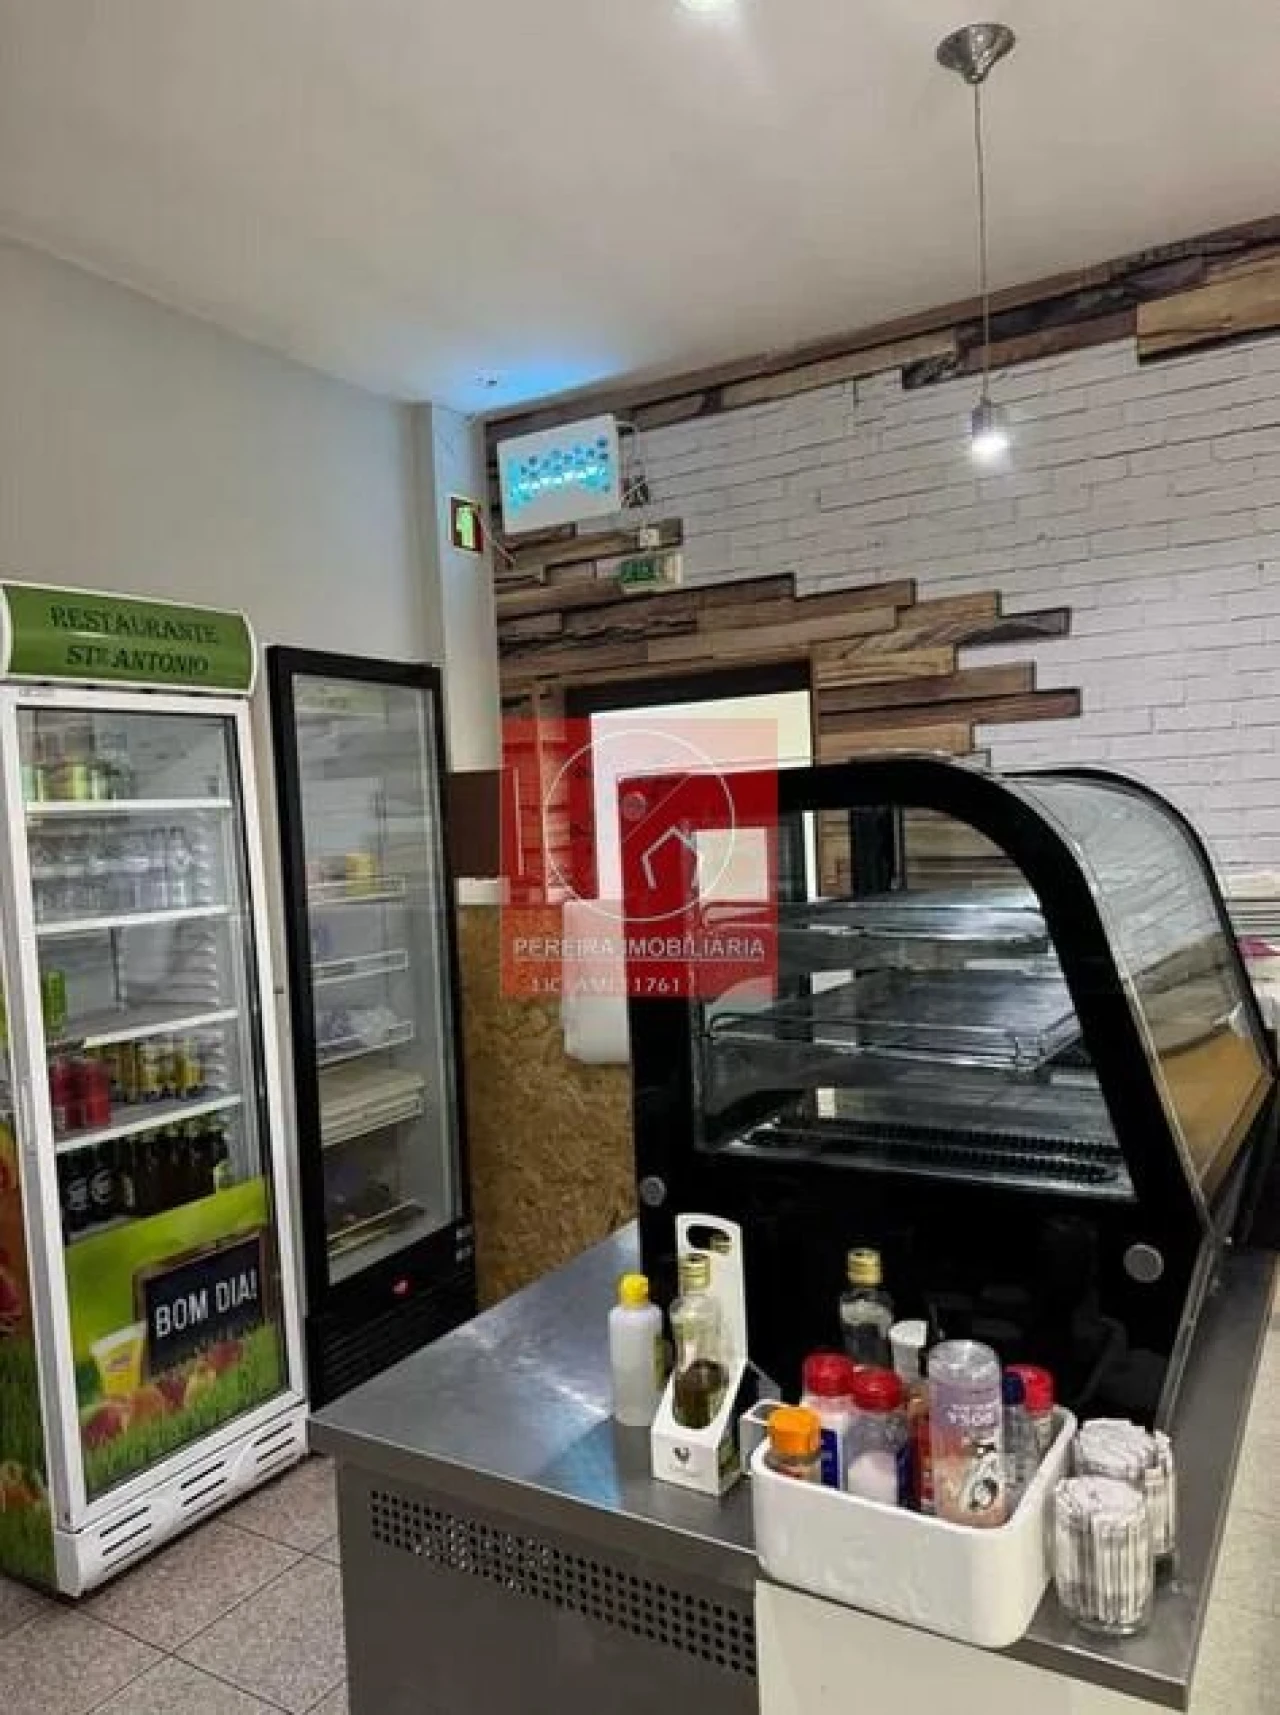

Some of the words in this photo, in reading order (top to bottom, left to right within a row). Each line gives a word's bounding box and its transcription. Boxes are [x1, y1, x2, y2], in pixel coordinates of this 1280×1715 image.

[50, 605, 218, 645] RESTAURANTE
[155, 1287, 209, 1339] BOM
[215, 1268, 258, 1314] DIA!
